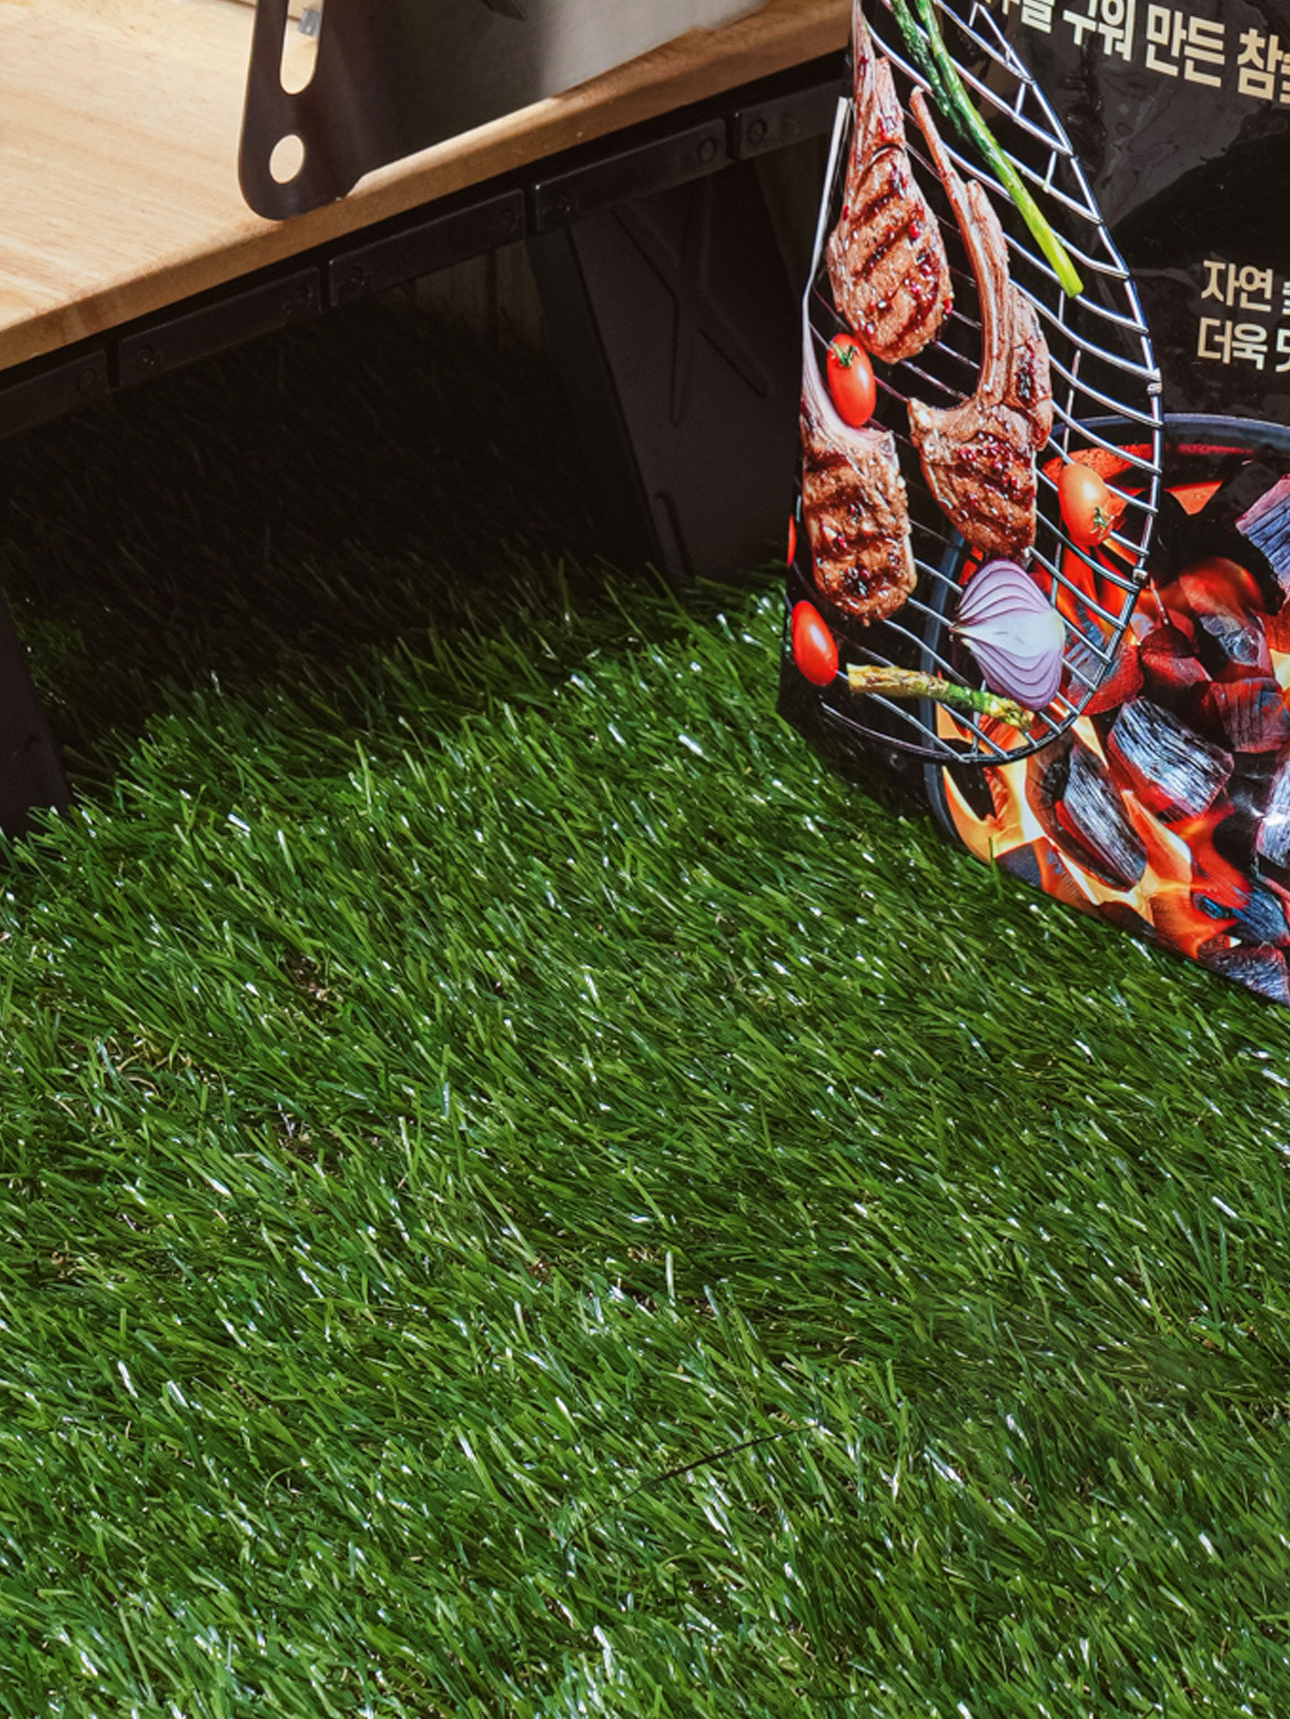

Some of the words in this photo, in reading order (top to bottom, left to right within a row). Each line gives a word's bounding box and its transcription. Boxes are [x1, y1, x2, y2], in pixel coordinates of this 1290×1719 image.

[1145, 3, 1226, 88] 만든
[1201, 260, 1274, 312] 자연
[1197, 316, 1268, 370] 더욱
